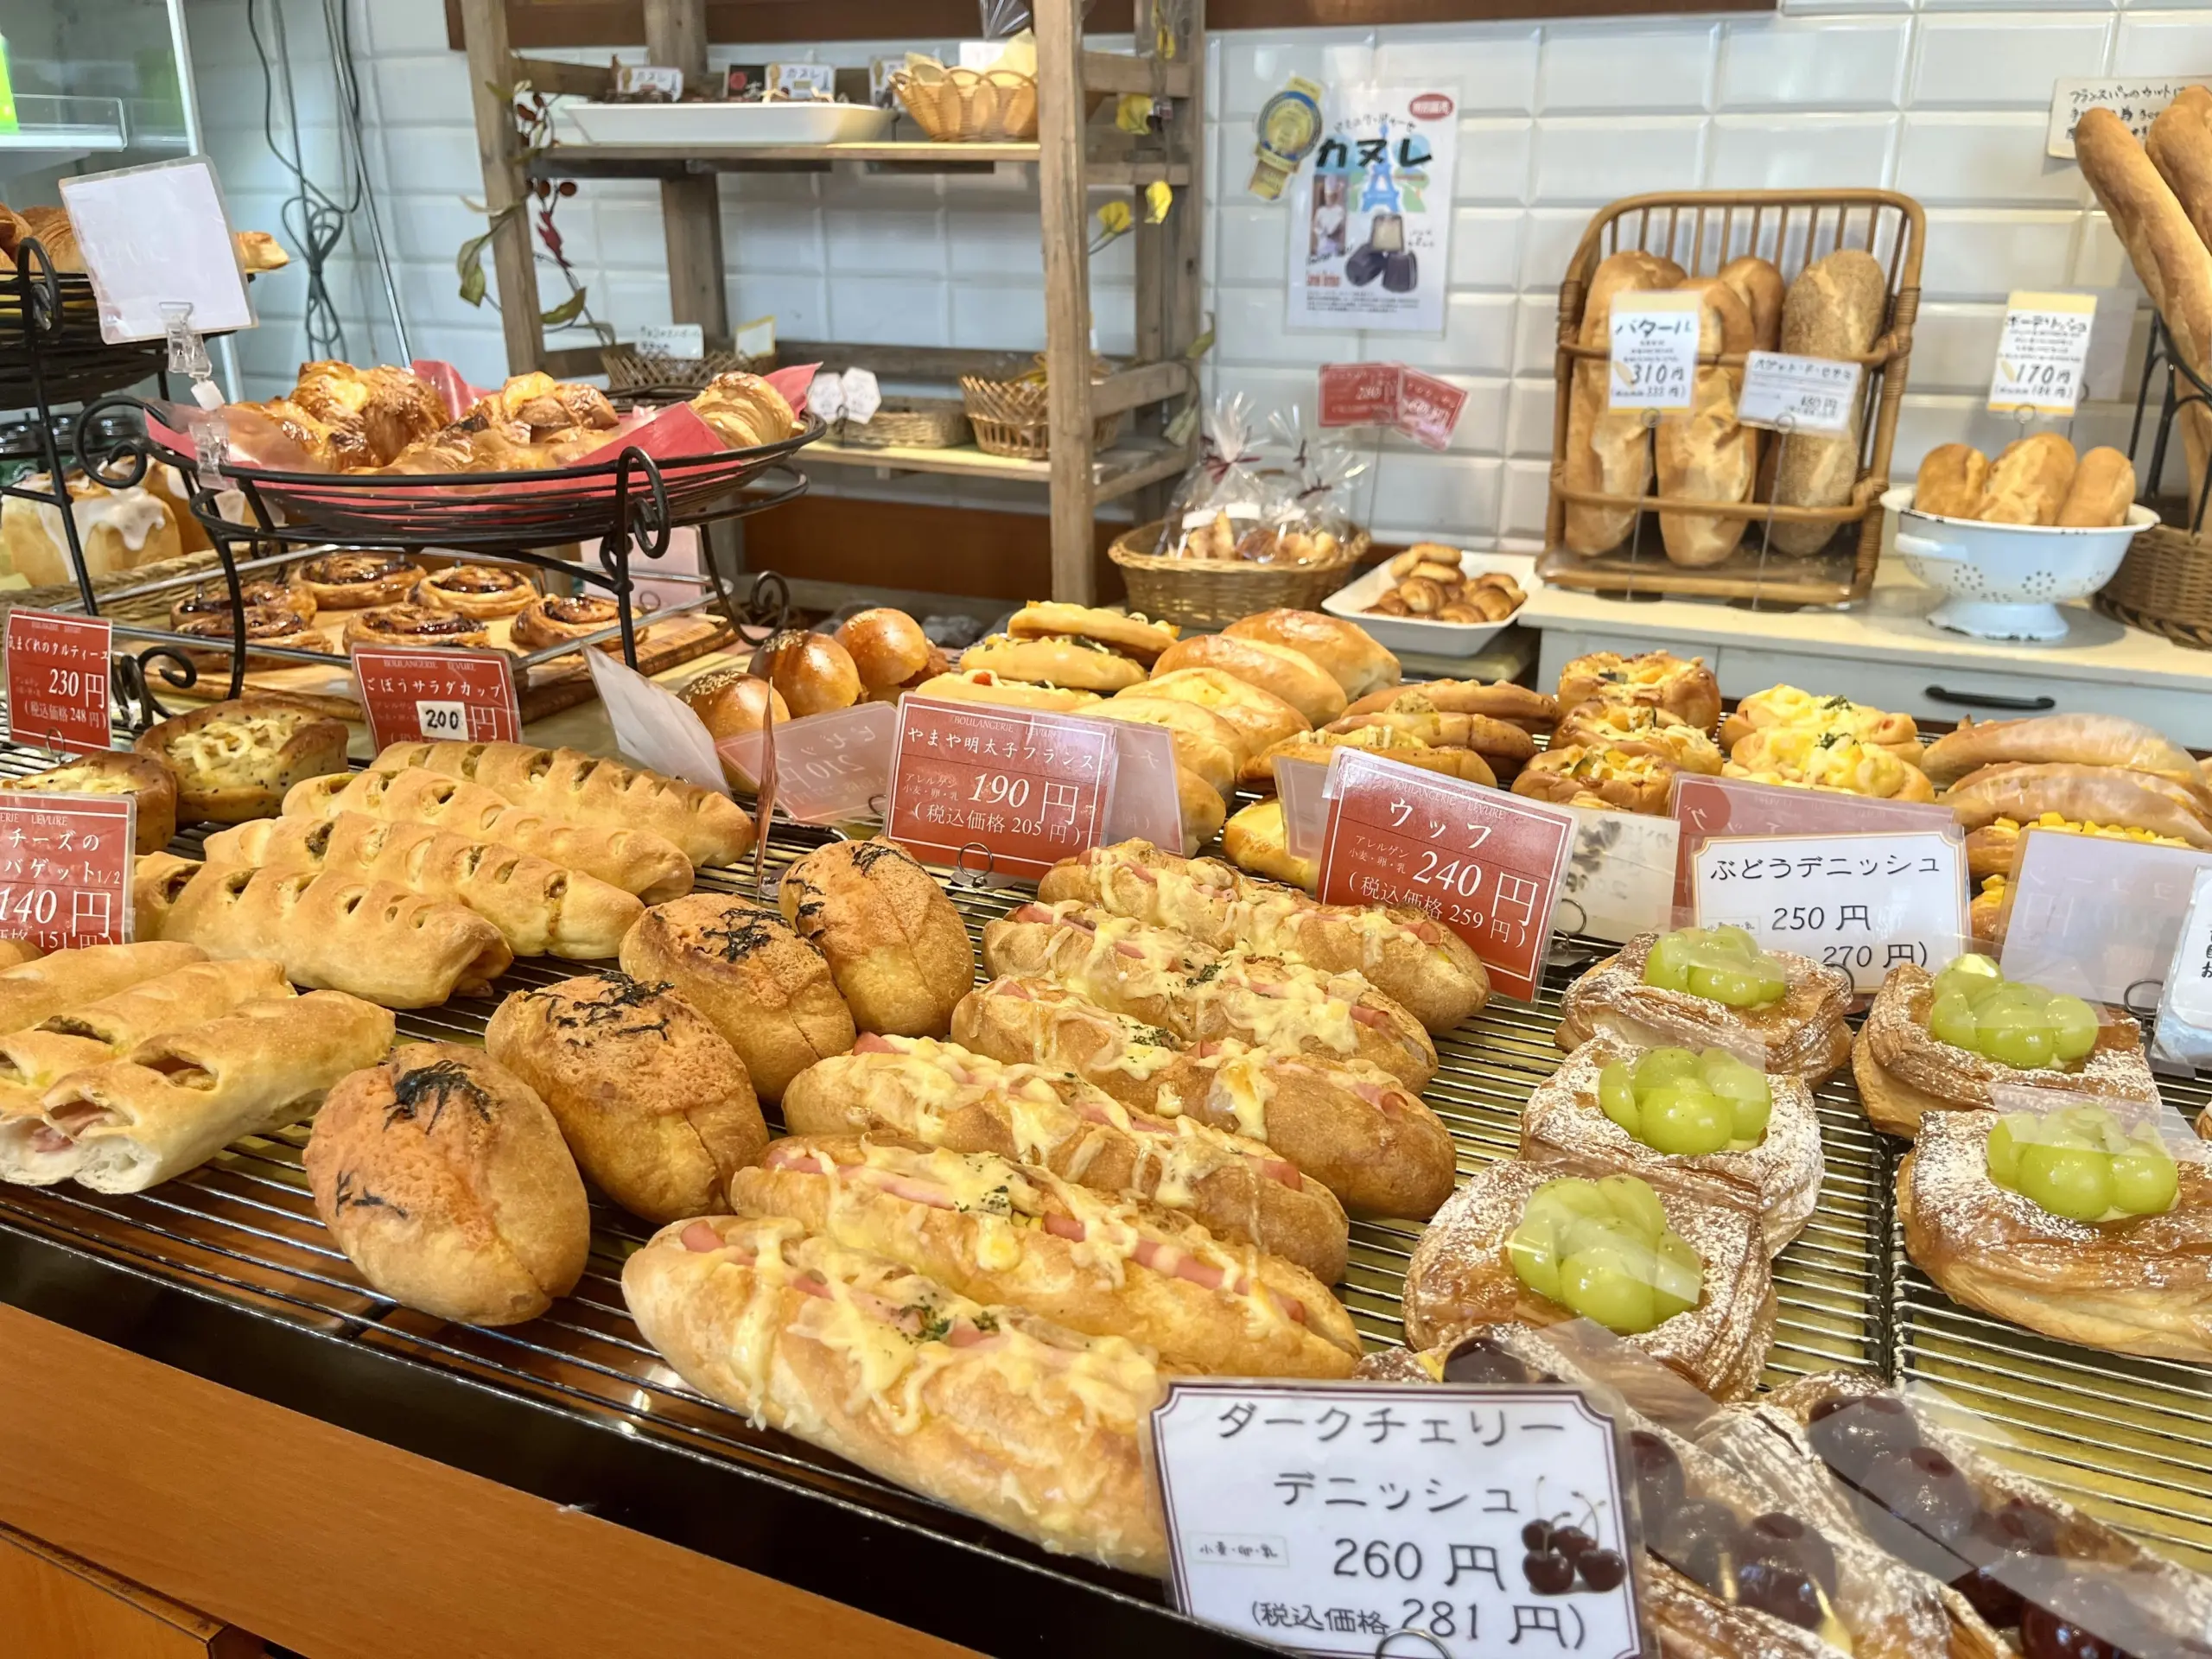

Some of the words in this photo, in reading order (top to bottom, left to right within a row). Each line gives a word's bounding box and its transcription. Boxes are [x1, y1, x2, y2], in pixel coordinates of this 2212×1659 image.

[1316, 138, 1433, 168] カヌレ
[1614, 317, 1693, 339] バタール
[1630, 364, 1668, 385] 310
[2016, 363, 2056, 385] 170
[48, 668, 79, 697] 230
[85, 672, 105, 709] 円
[365, 677, 503, 698] ごぼうサラダカップ
[70, 707, 86, 723] 248
[424, 709, 461, 731] 200
[954, 715, 1014, 733] BOULANGERIE
[907, 728, 1094, 770] やまや明太子フランス
[967, 772, 1030, 808] 190
[1040, 780, 1080, 826] 円
[1466, 802, 1506, 820] LEVURE
[31, 814, 68, 827] LEVURE
[1011, 817, 1042, 836] 205
[1390, 797, 1492, 849] ウッフ
[8, 828, 100, 852] チーズの
[1355, 835, 1411, 859] アレルゲン
[1709, 855, 1941, 882] ぶどうデニッシュ
[1412, 850, 1483, 898] 240
[1491, 870, 1539, 927] 円
[0, 886, 58, 925] 140
[72, 889, 111, 938] 円
[1448, 904, 1484, 930] 259
[1771, 906, 1826, 931] 250
[1835, 905, 1872, 931] 円
[38, 929, 68, 950] 151
[1823, 944, 1872, 968] 270
[1217, 1400, 1566, 1447] ダークチェリー
[1273, 1471, 1519, 1515] デニッシュ
[1332, 1537, 1424, 1581] 260
[1444, 1542, 1507, 1592] 円
[1251, 1602, 1390, 1636] (税込価格
[1401, 1598, 1480, 1640] 281
